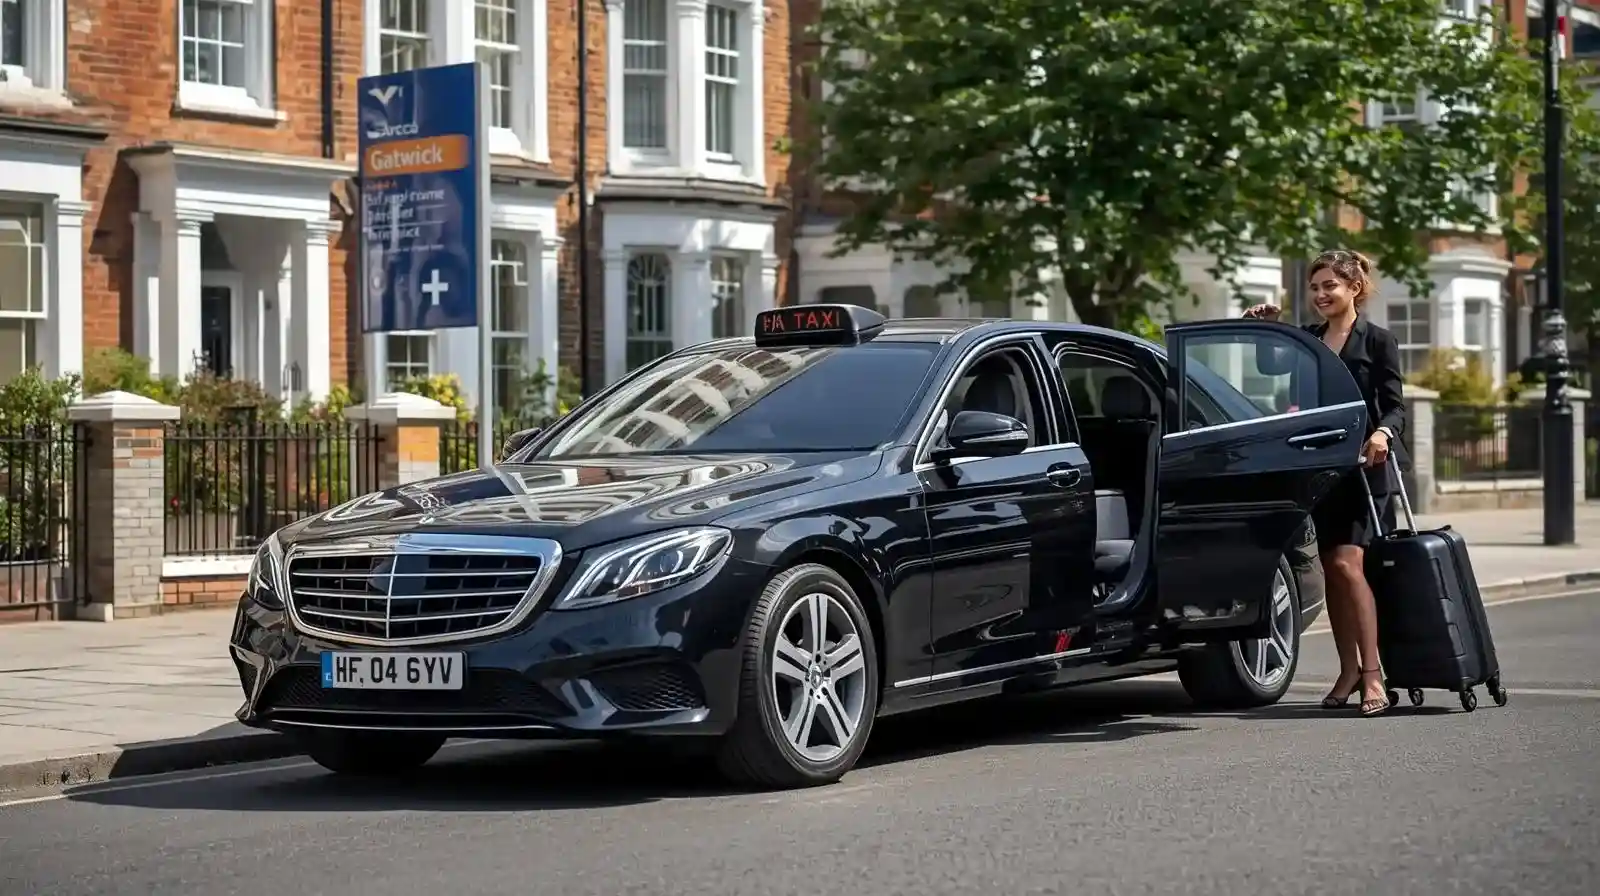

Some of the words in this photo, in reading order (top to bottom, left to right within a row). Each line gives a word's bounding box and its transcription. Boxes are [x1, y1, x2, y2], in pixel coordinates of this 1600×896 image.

[370, 143, 443, 171] Gatwick
[794, 311, 840, 329] TAXI
[370, 656, 398, 684] 04
[406, 656, 453, 685] 6YV
